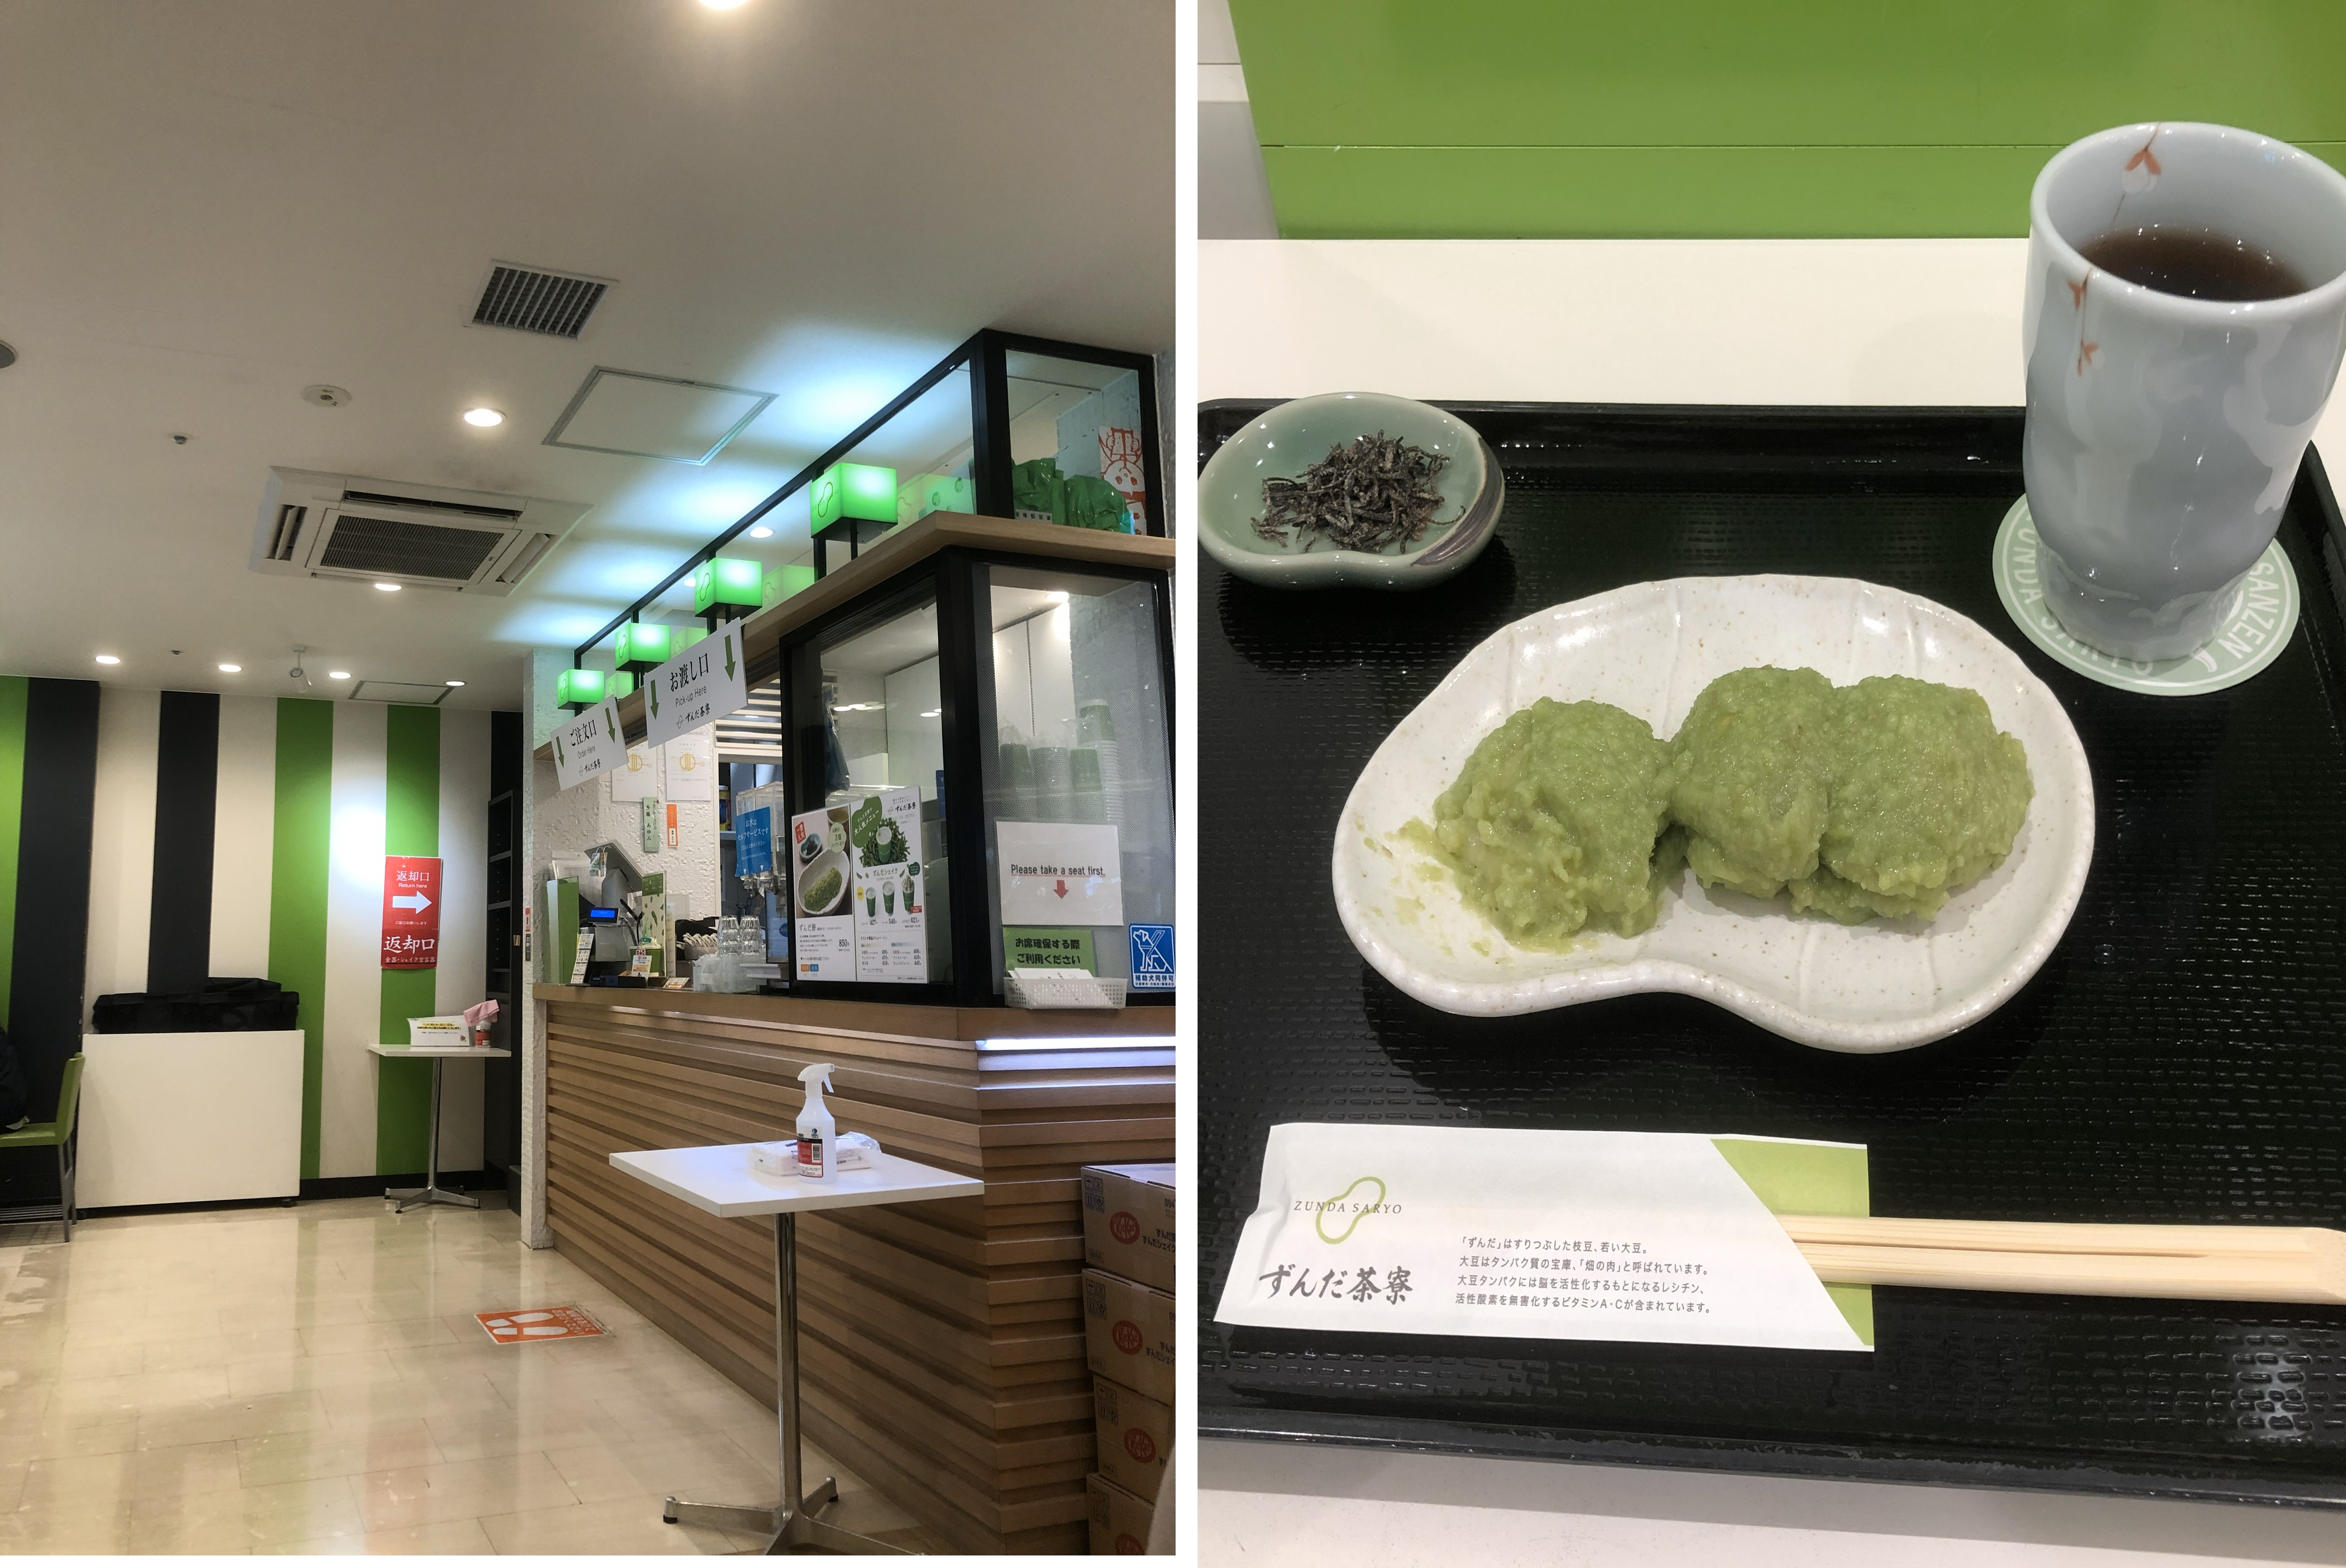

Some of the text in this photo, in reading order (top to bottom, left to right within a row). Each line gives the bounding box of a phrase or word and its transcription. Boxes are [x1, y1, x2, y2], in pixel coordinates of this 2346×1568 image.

[2013, 514, 2043, 605] UNDA
[2217, 562, 2280, 659] SANZEN
[670, 653, 709, 692] お渡し口
[676, 686, 707, 707] Pick-up Here
[685, 703, 711, 723] ずんだ茶寮
[570, 719, 597, 746] ご注文口
[577, 746, 596, 759] Order Here
[746, 818, 757, 827] お水は
[738, 827, 769, 841] セルフサービスです
[396, 870, 429, 881] 返却口
[1011, 864, 1037, 874] Please
[1041, 865, 1058, 875] take
[1069, 866, 1085, 875] seat
[1088, 866, 1106, 876] first.
[384, 934, 435, 954] 返却口
[1015, 938, 1080, 950] お席確保する際
[1017, 953, 1081, 965] ご利用ください
[1294, 1201, 1402, 1214] ZUNDA SARYO
[1113, 1217, 1136, 1239] KitKat
[1462, 1236, 1646, 1254] 「ずんだ」はすりつぶした枝豆、若い大豆。
[1259, 1264, 1413, 1305] ずんだ茶寮
